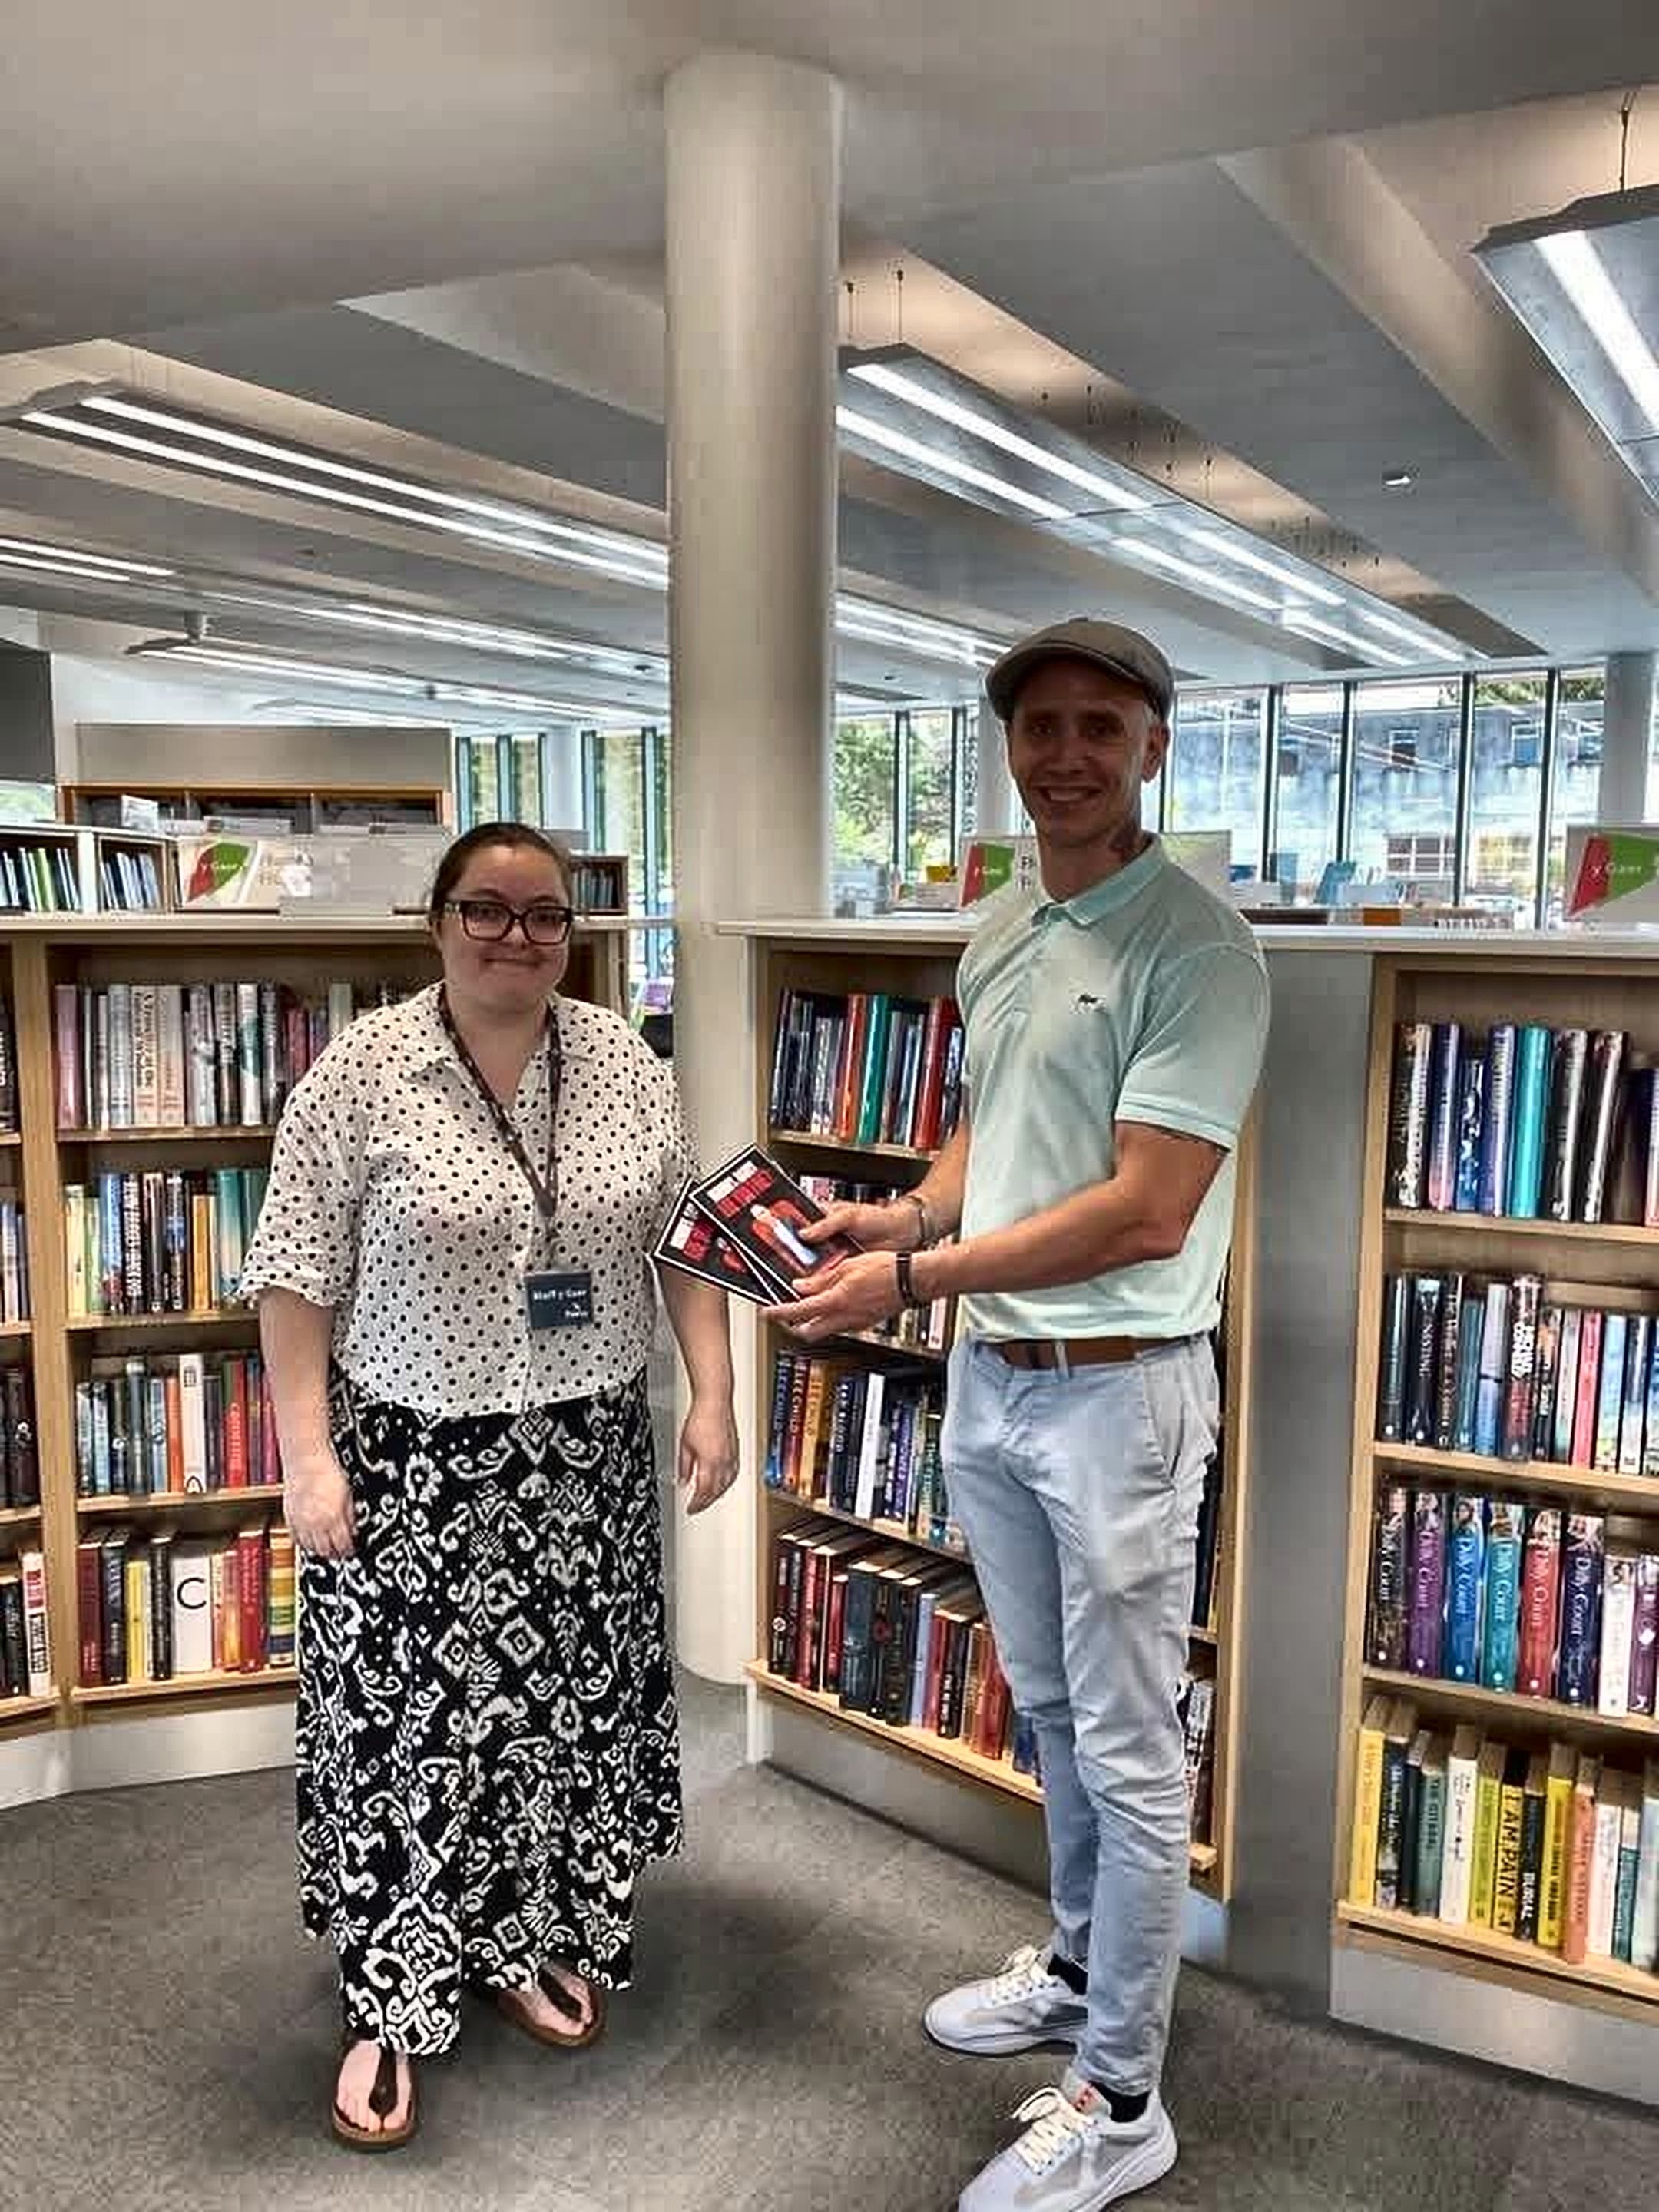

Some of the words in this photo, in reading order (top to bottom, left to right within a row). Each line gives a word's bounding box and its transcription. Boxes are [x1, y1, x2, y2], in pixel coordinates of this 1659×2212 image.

[790, 1396, 803, 1434] CHILD
[1456, 1573, 1474, 1614] Court
[1571, 1555, 1591, 1592] Dilly
[1495, 1580, 1511, 1621] Court
[1571, 1594, 1588, 1636] Court
